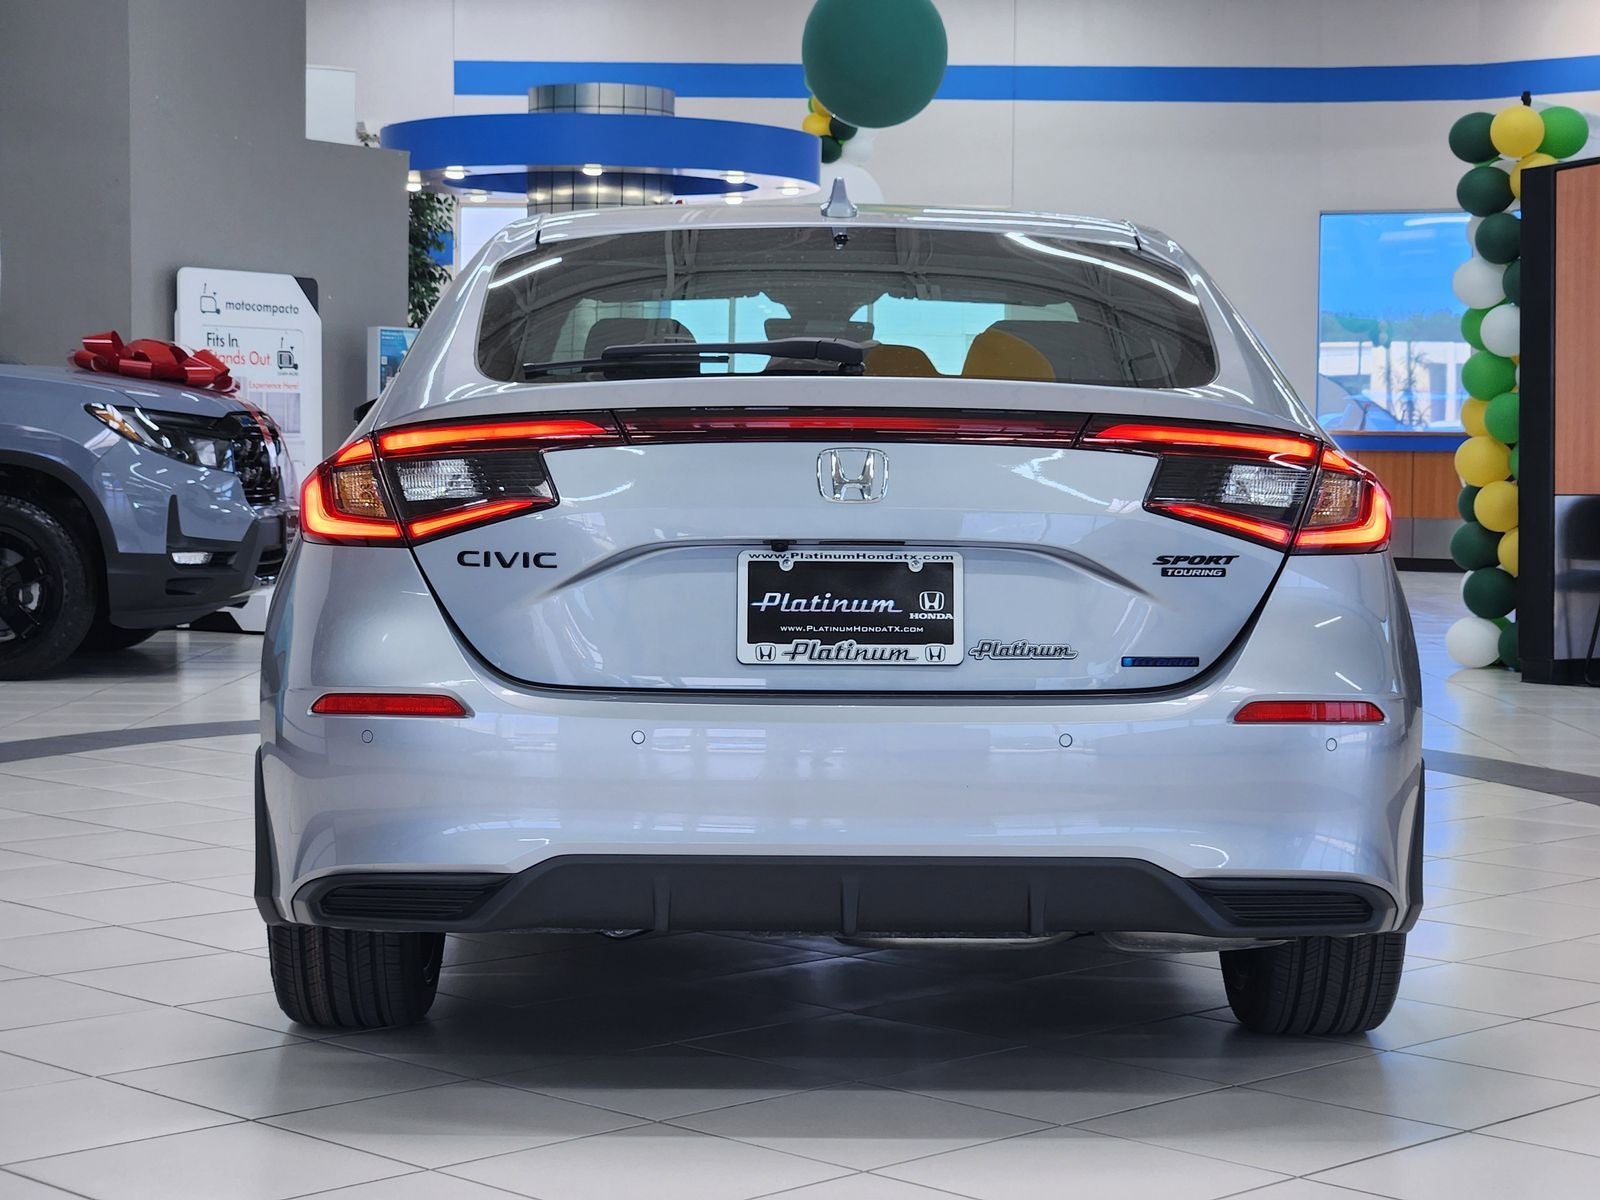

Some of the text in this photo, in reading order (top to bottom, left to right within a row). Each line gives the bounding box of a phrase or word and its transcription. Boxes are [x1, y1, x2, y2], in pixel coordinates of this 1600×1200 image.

[225, 300, 299, 316] motocompacto
[206, 331, 225, 348] Fits
[457, 551, 557, 568] CIVIC
[1152, 555, 1240, 565] SPORT
[1166, 568, 1223, 576] TOURING
[751, 592, 903, 613] Platinum
[909, 612, 953, 620] HONDA
[781, 640, 918, 662] Platinum
[969, 640, 1078, 660] Platinum
